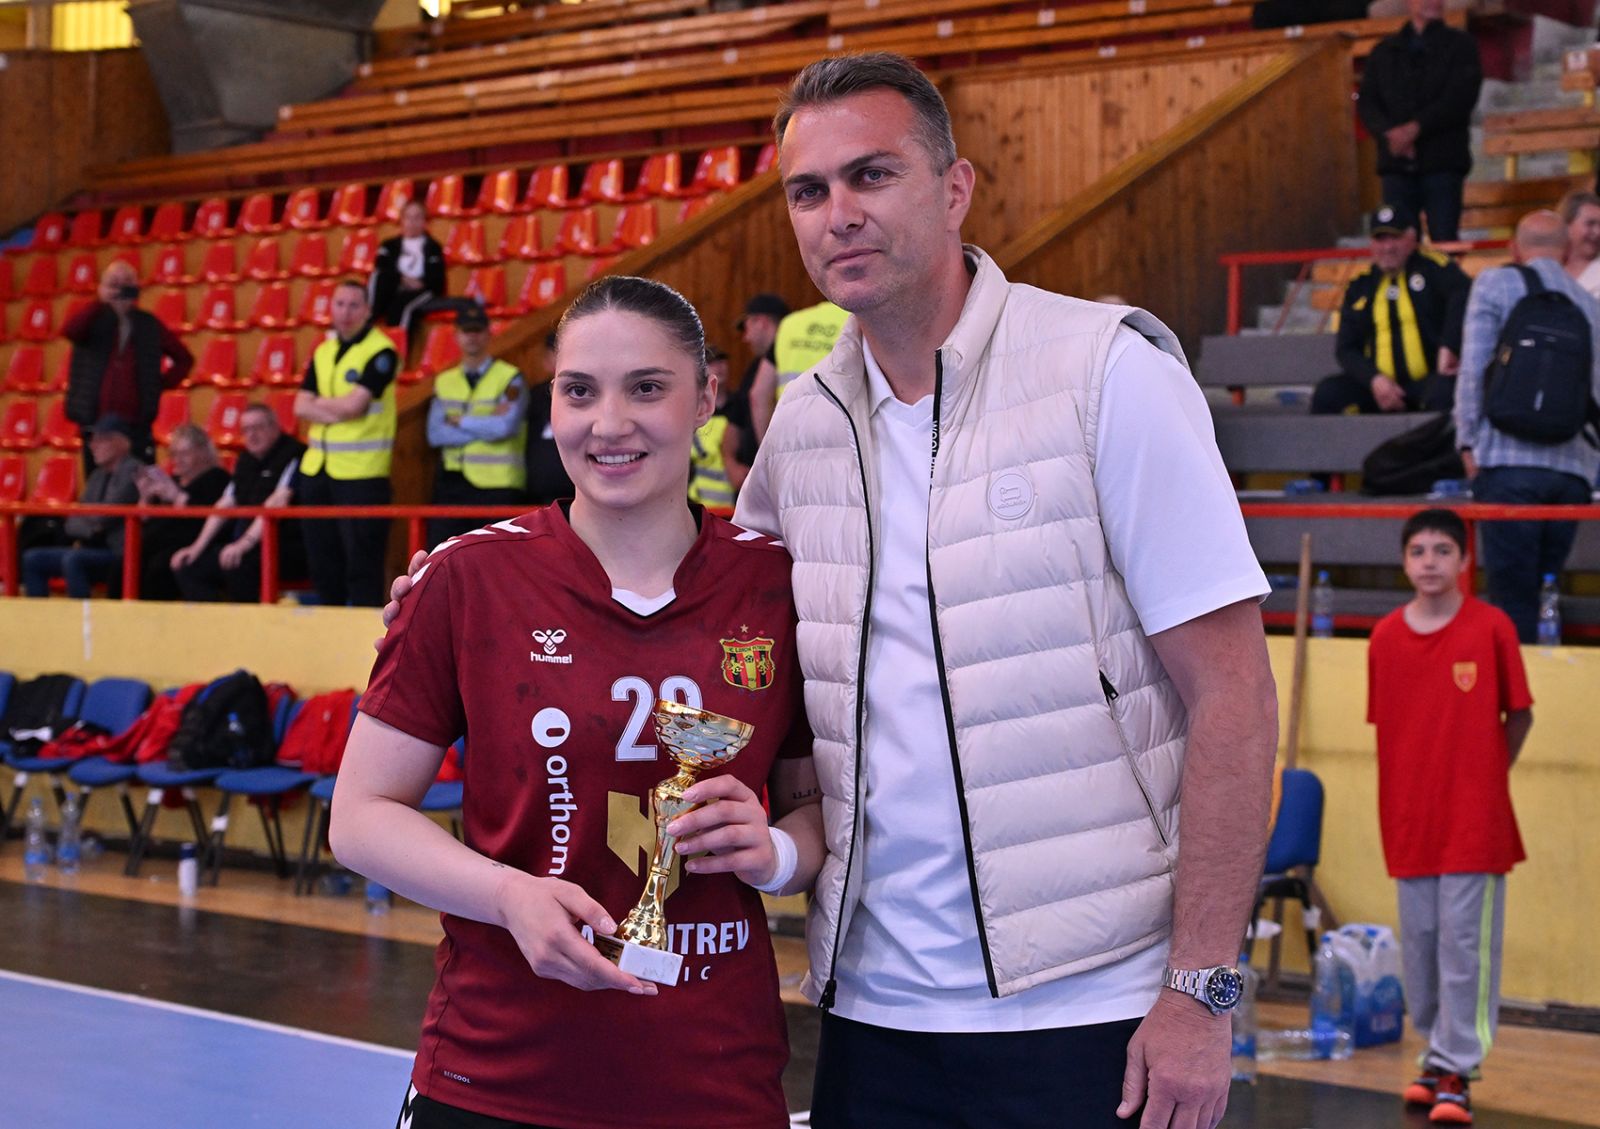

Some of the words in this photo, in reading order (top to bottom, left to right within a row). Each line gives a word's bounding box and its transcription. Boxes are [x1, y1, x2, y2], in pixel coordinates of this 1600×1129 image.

[530, 651, 573, 664] hummel
[546, 755, 578, 875] orthom
[667, 918, 750, 955] ITREV
